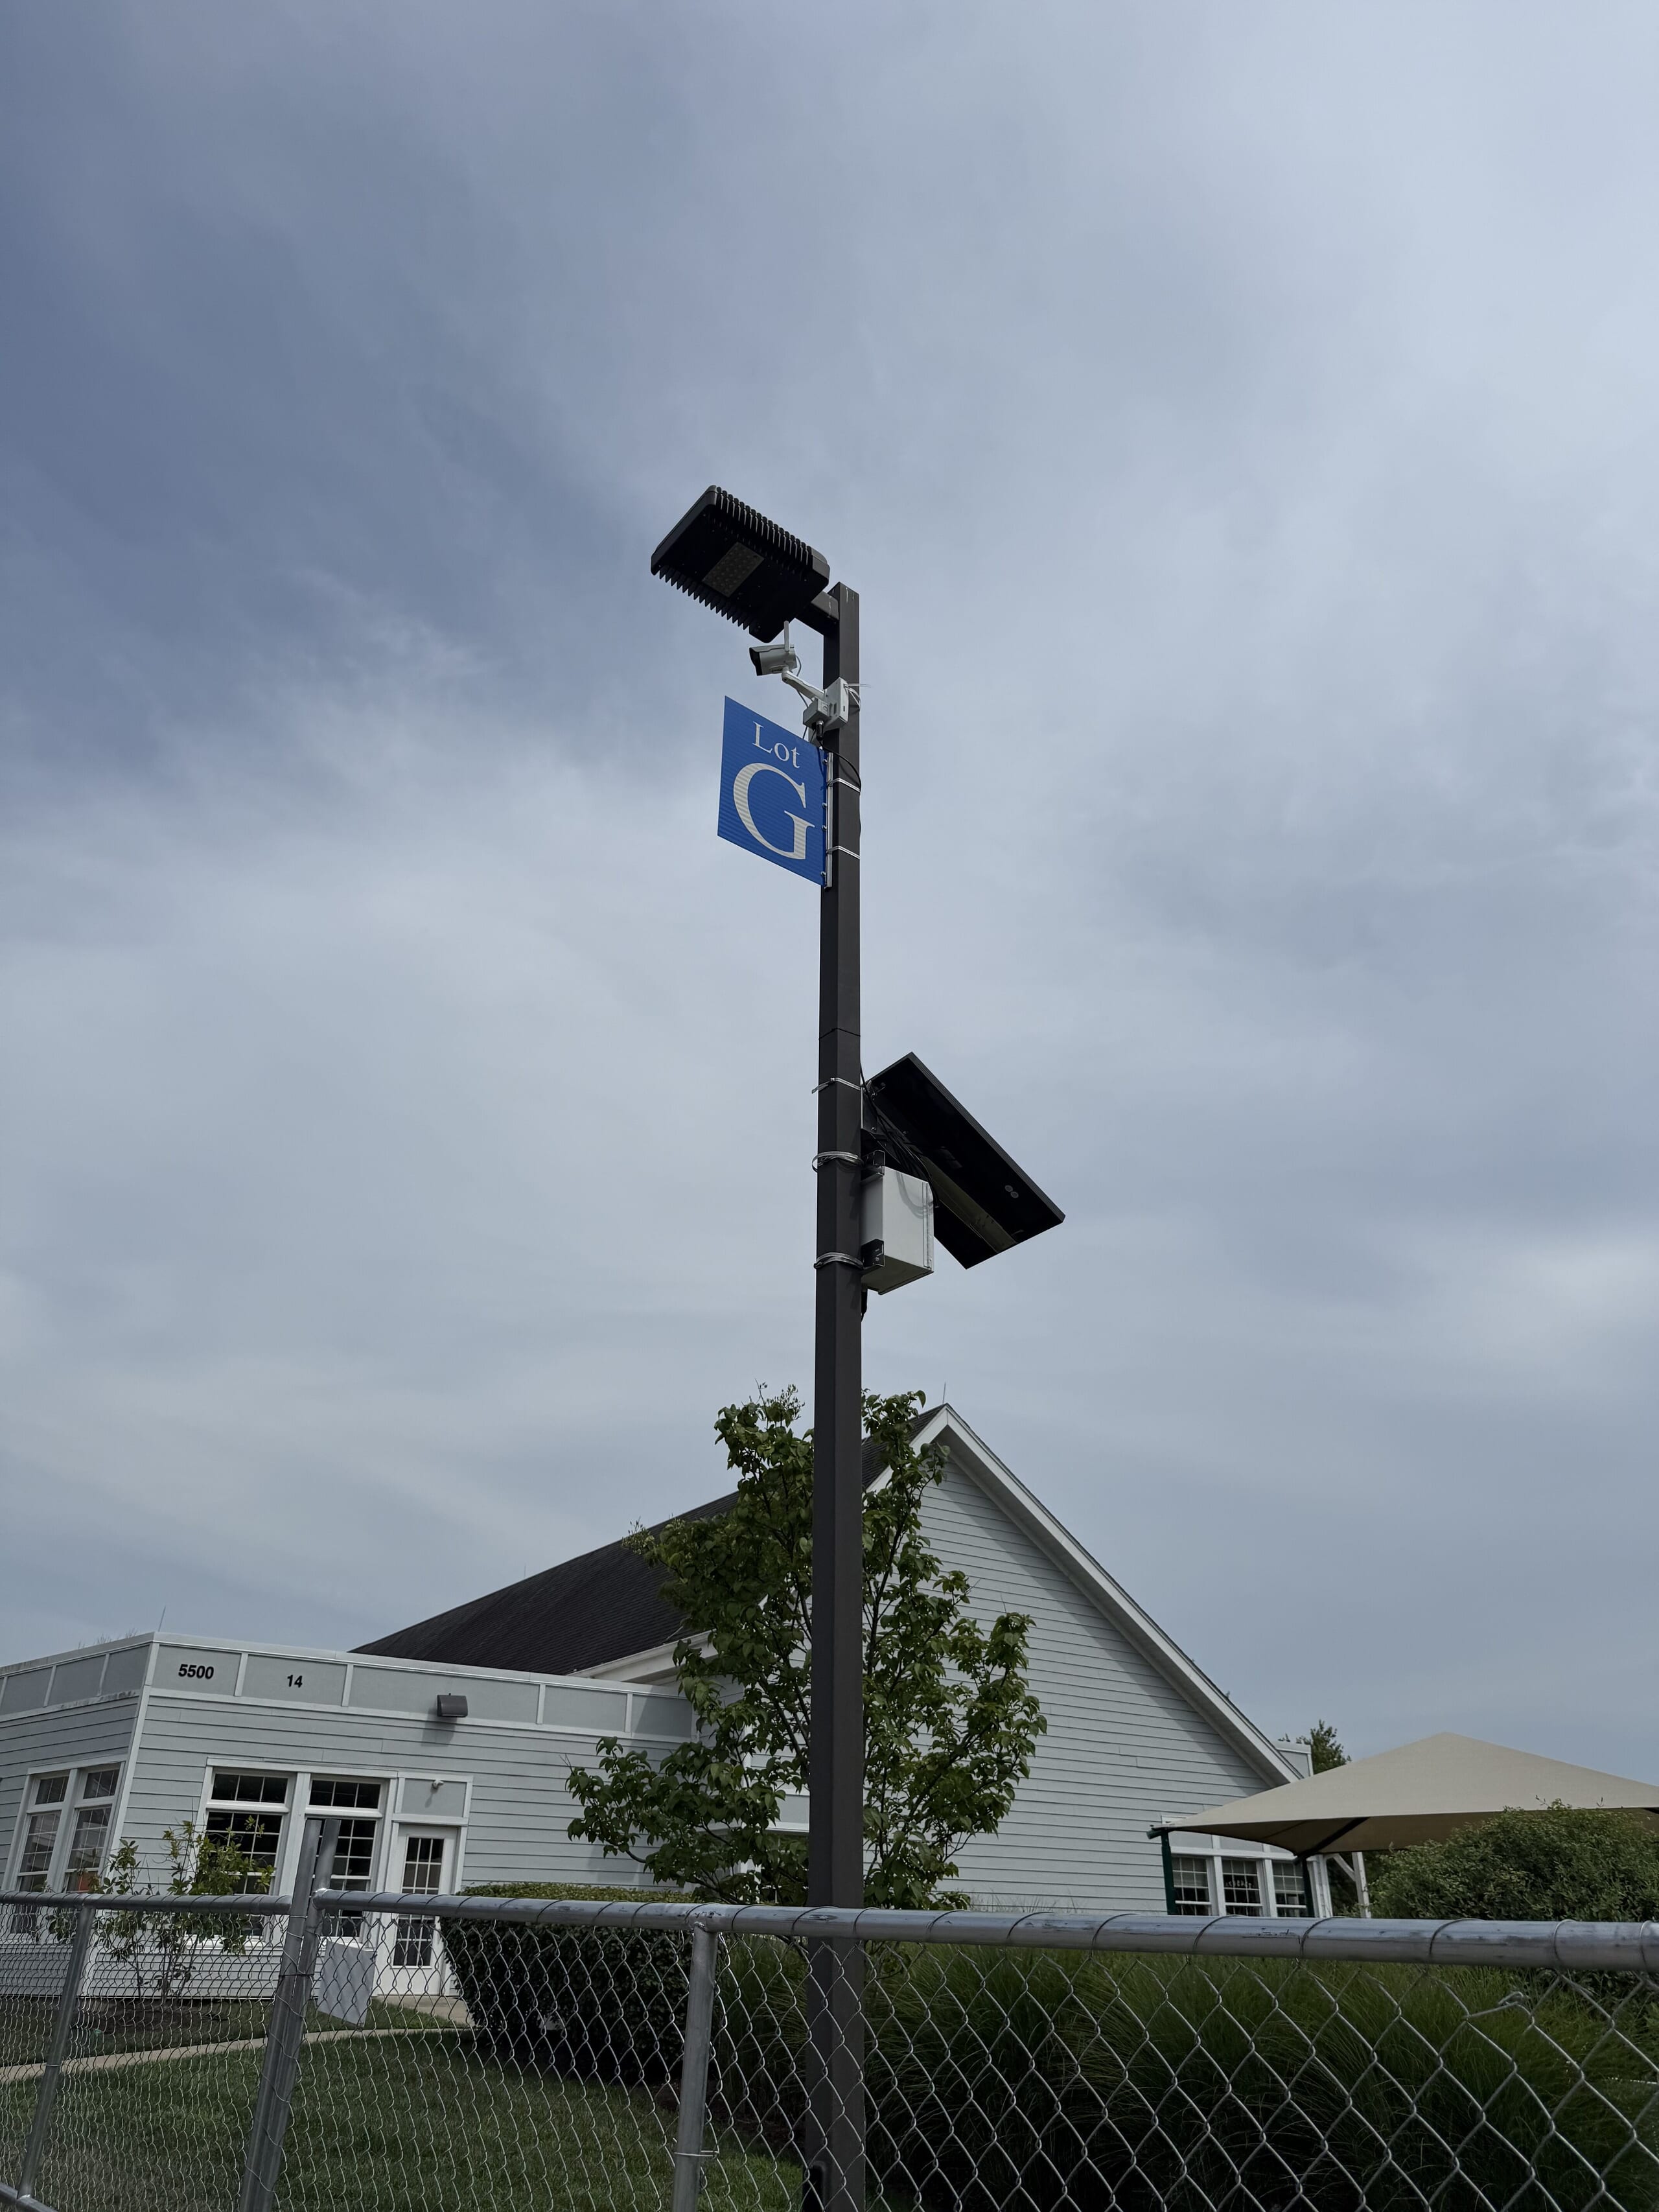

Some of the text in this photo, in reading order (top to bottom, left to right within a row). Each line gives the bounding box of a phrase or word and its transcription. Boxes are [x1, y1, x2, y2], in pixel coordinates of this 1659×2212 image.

[752, 722, 800, 769] Lot
[733, 762, 815, 860] G
[178, 1664, 215, 1680] 5500
[287, 1674, 303, 1688] 14
